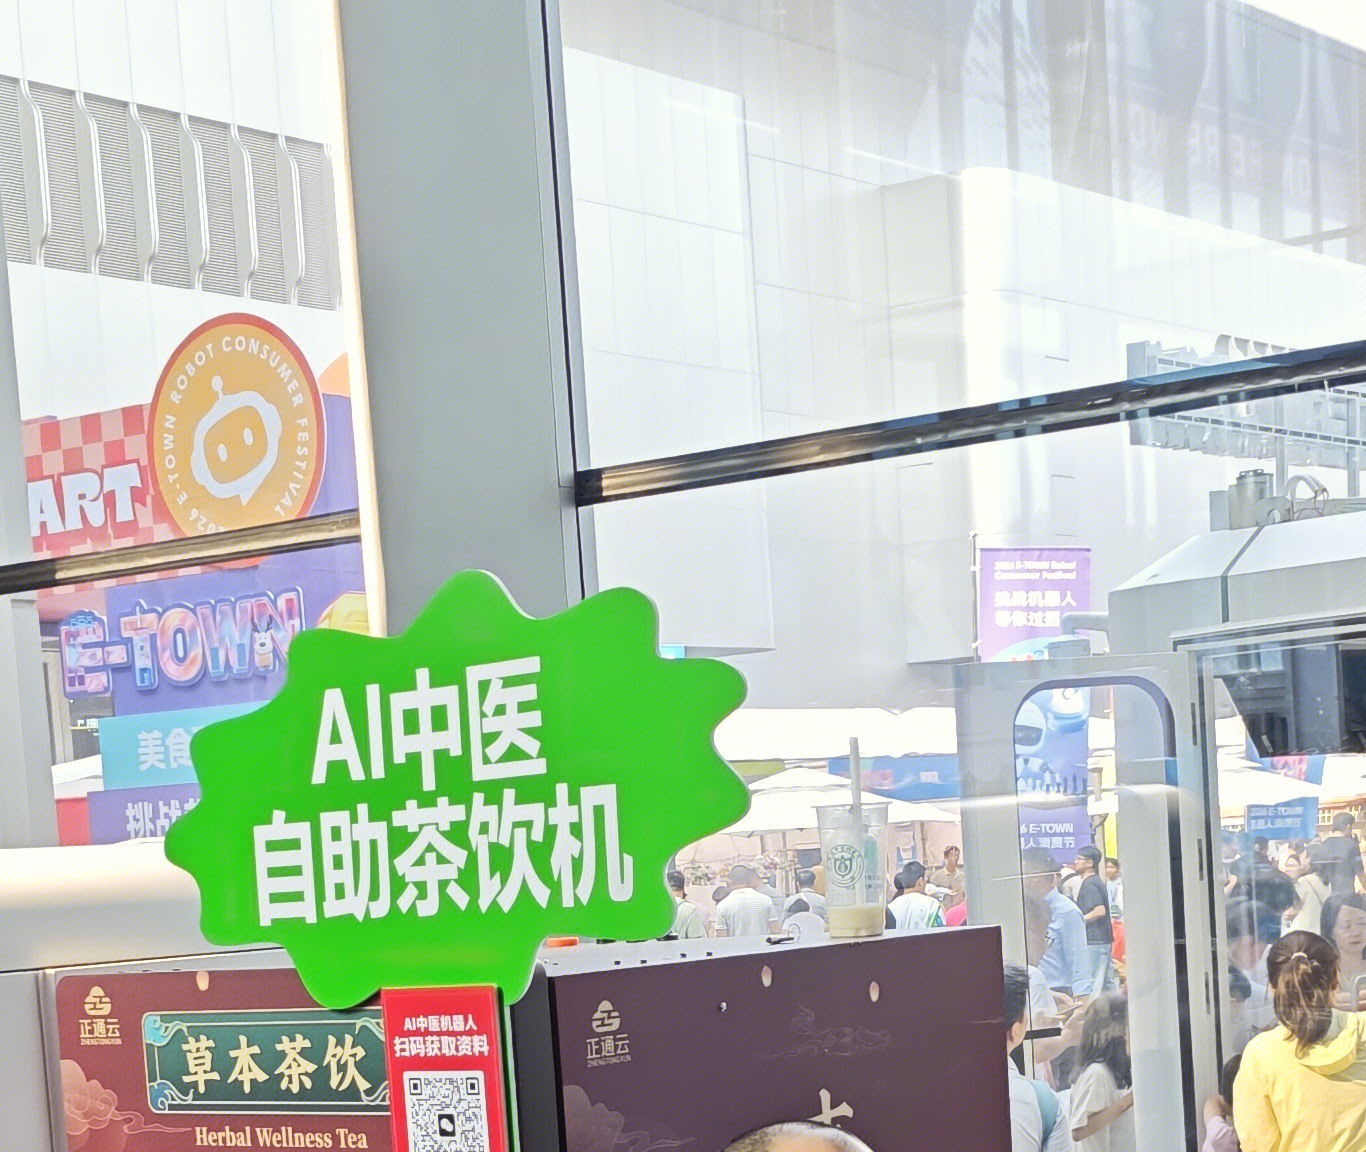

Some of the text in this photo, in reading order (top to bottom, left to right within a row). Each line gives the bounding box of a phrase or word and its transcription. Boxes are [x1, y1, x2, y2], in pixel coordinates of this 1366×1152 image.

[170, 343, 214, 405] ROBOT
[222, 335, 305, 408] CONSUMER
[163, 414, 190, 506] E-TOWN
[273, 417, 310, 519] FESTIVAL
[61, 588, 304, 694] E-TOWN
[310, 655, 548, 792] AI中医
[137, 727, 195, 772] 美食
[126, 798, 201, 839] 挑战
[1029, 823, 1074, 834] E-TOWN
[252, 783, 634, 927] 自助茶饮机
[1020, 836, 1075, 850] 人消费节
[78, 1018, 121, 1038] 正通云
[394, 1034, 489, 1057] 扫码获取资料
[403, 1014, 477, 1032] AI中医机器人
[181, 1033, 373, 1095] 草本茶饮
[586, 1033, 630, 1059] 正通云
[195, 1126, 369, 1149] Herbal Wellness Tea
